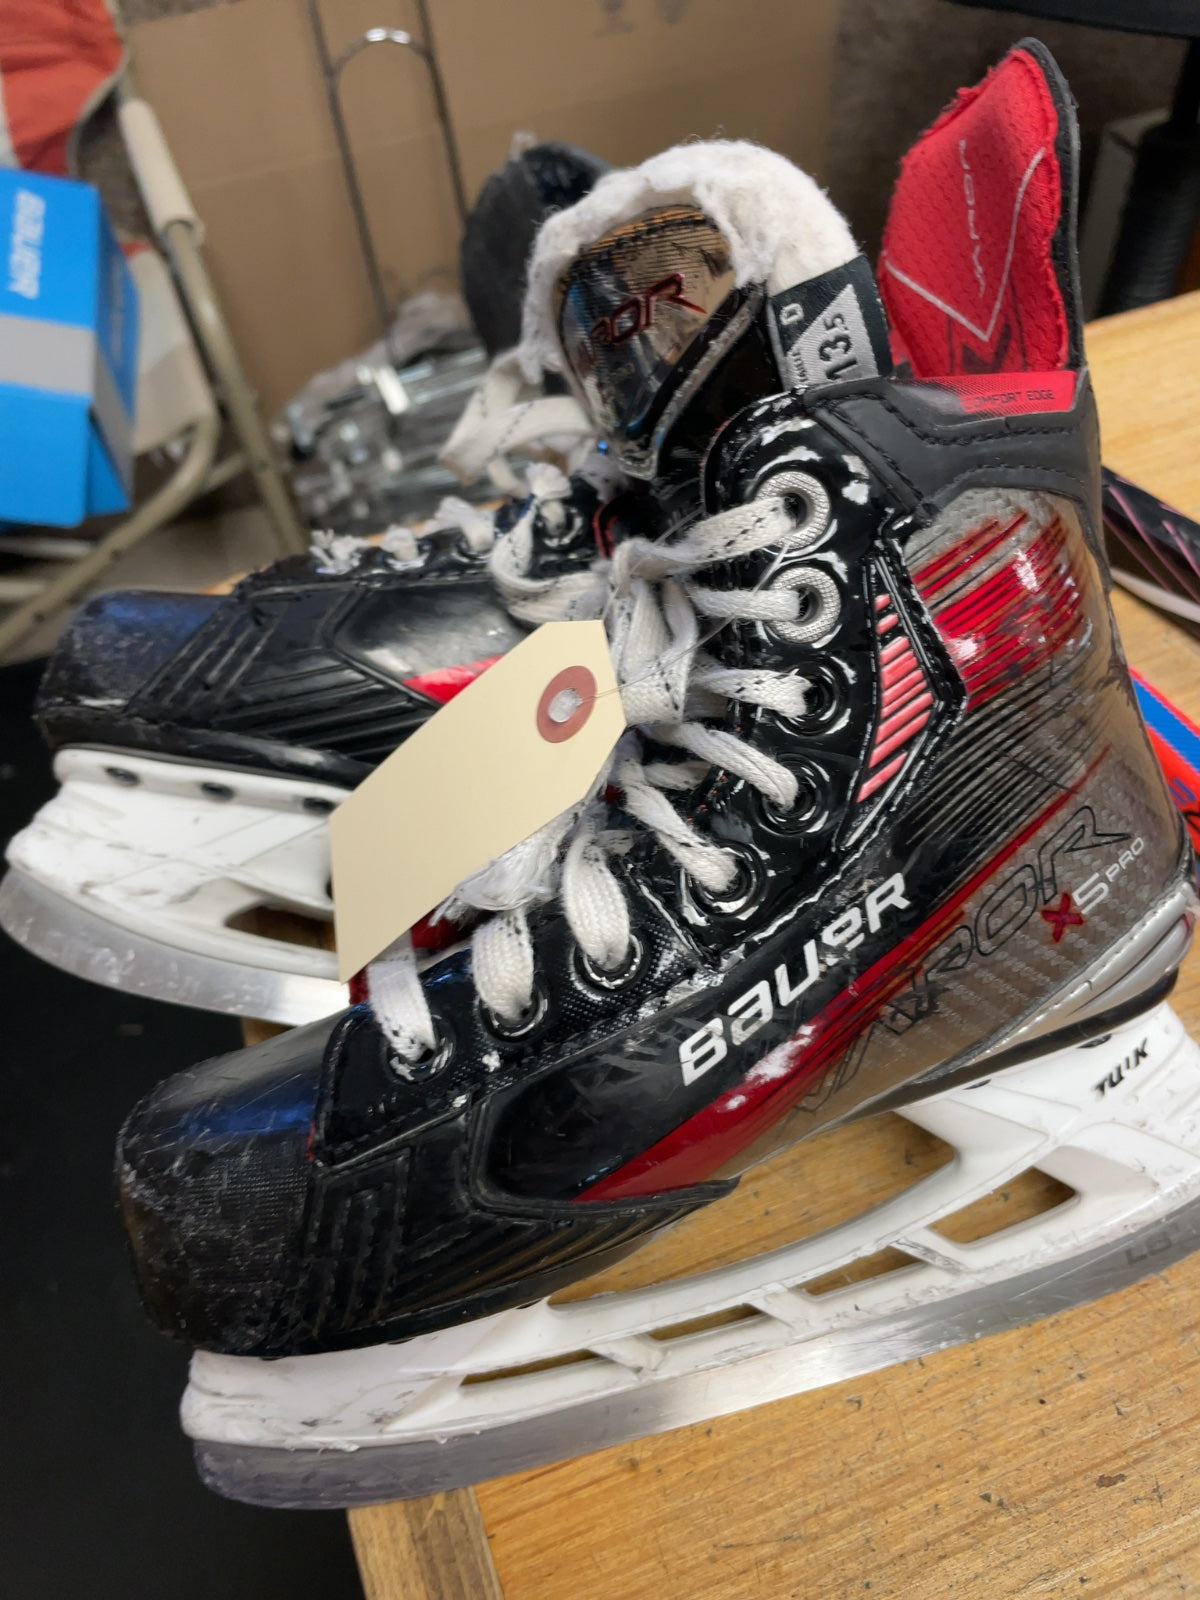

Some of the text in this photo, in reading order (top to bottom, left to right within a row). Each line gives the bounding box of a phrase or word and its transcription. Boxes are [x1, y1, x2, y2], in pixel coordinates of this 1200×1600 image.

[780, 302, 804, 327] D
[963, 388, 1056, 411] COMFORT EDGE
[1105, 836, 1145, 883] PRO
[678, 871, 911, 1087] BAUER
